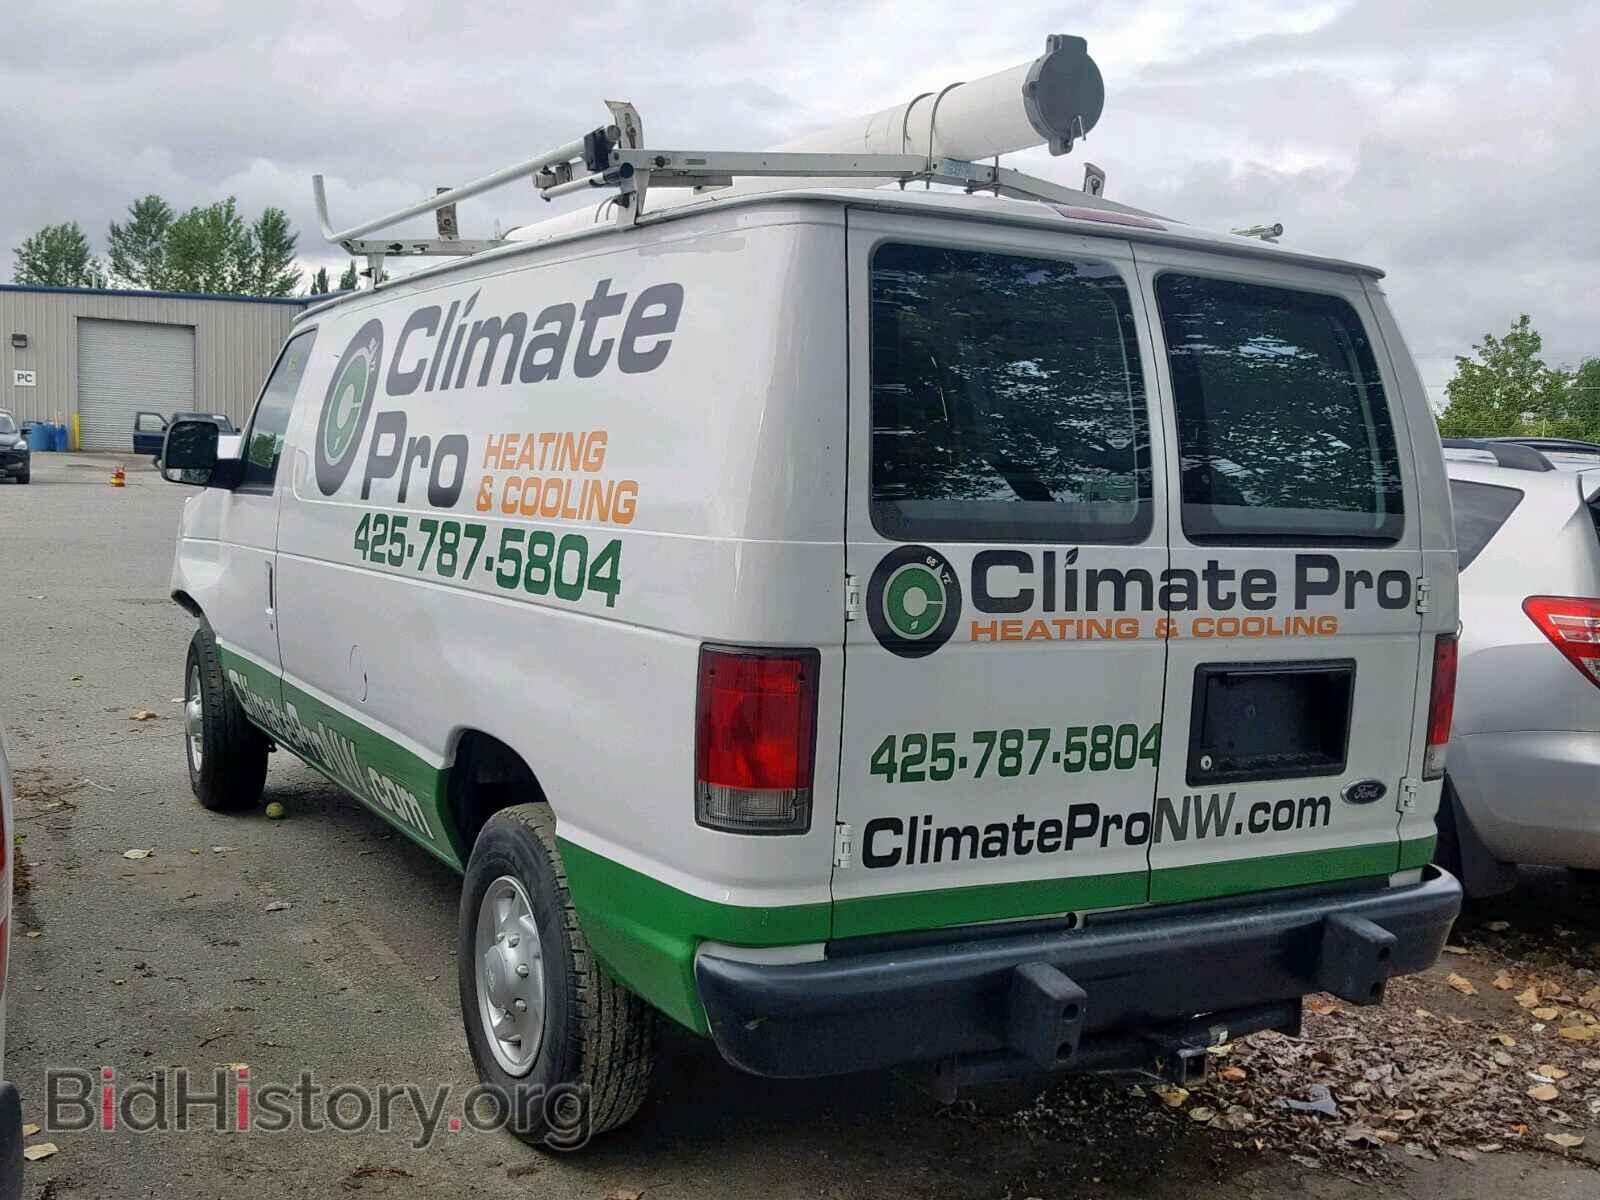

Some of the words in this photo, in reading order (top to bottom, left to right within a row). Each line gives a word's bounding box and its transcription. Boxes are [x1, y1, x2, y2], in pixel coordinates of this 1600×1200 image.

[386, 279, 684, 396] Climate
[17, 373, 33, 383] PC
[361, 411, 469, 507] Pro
[482, 431, 608, 472] HEATING
[475, 475, 493, 512] &
[501, 476, 639, 524] COOLING
[971, 546, 1277, 614] Climate
[1294, 554, 1411, 611] Pro
[971, 618, 1139, 641] HEATING
[1155, 618, 1178, 638] &
[1191, 615, 1338, 638] COOLING
[862, 792, 1331, 869] ClimateProNW.com
